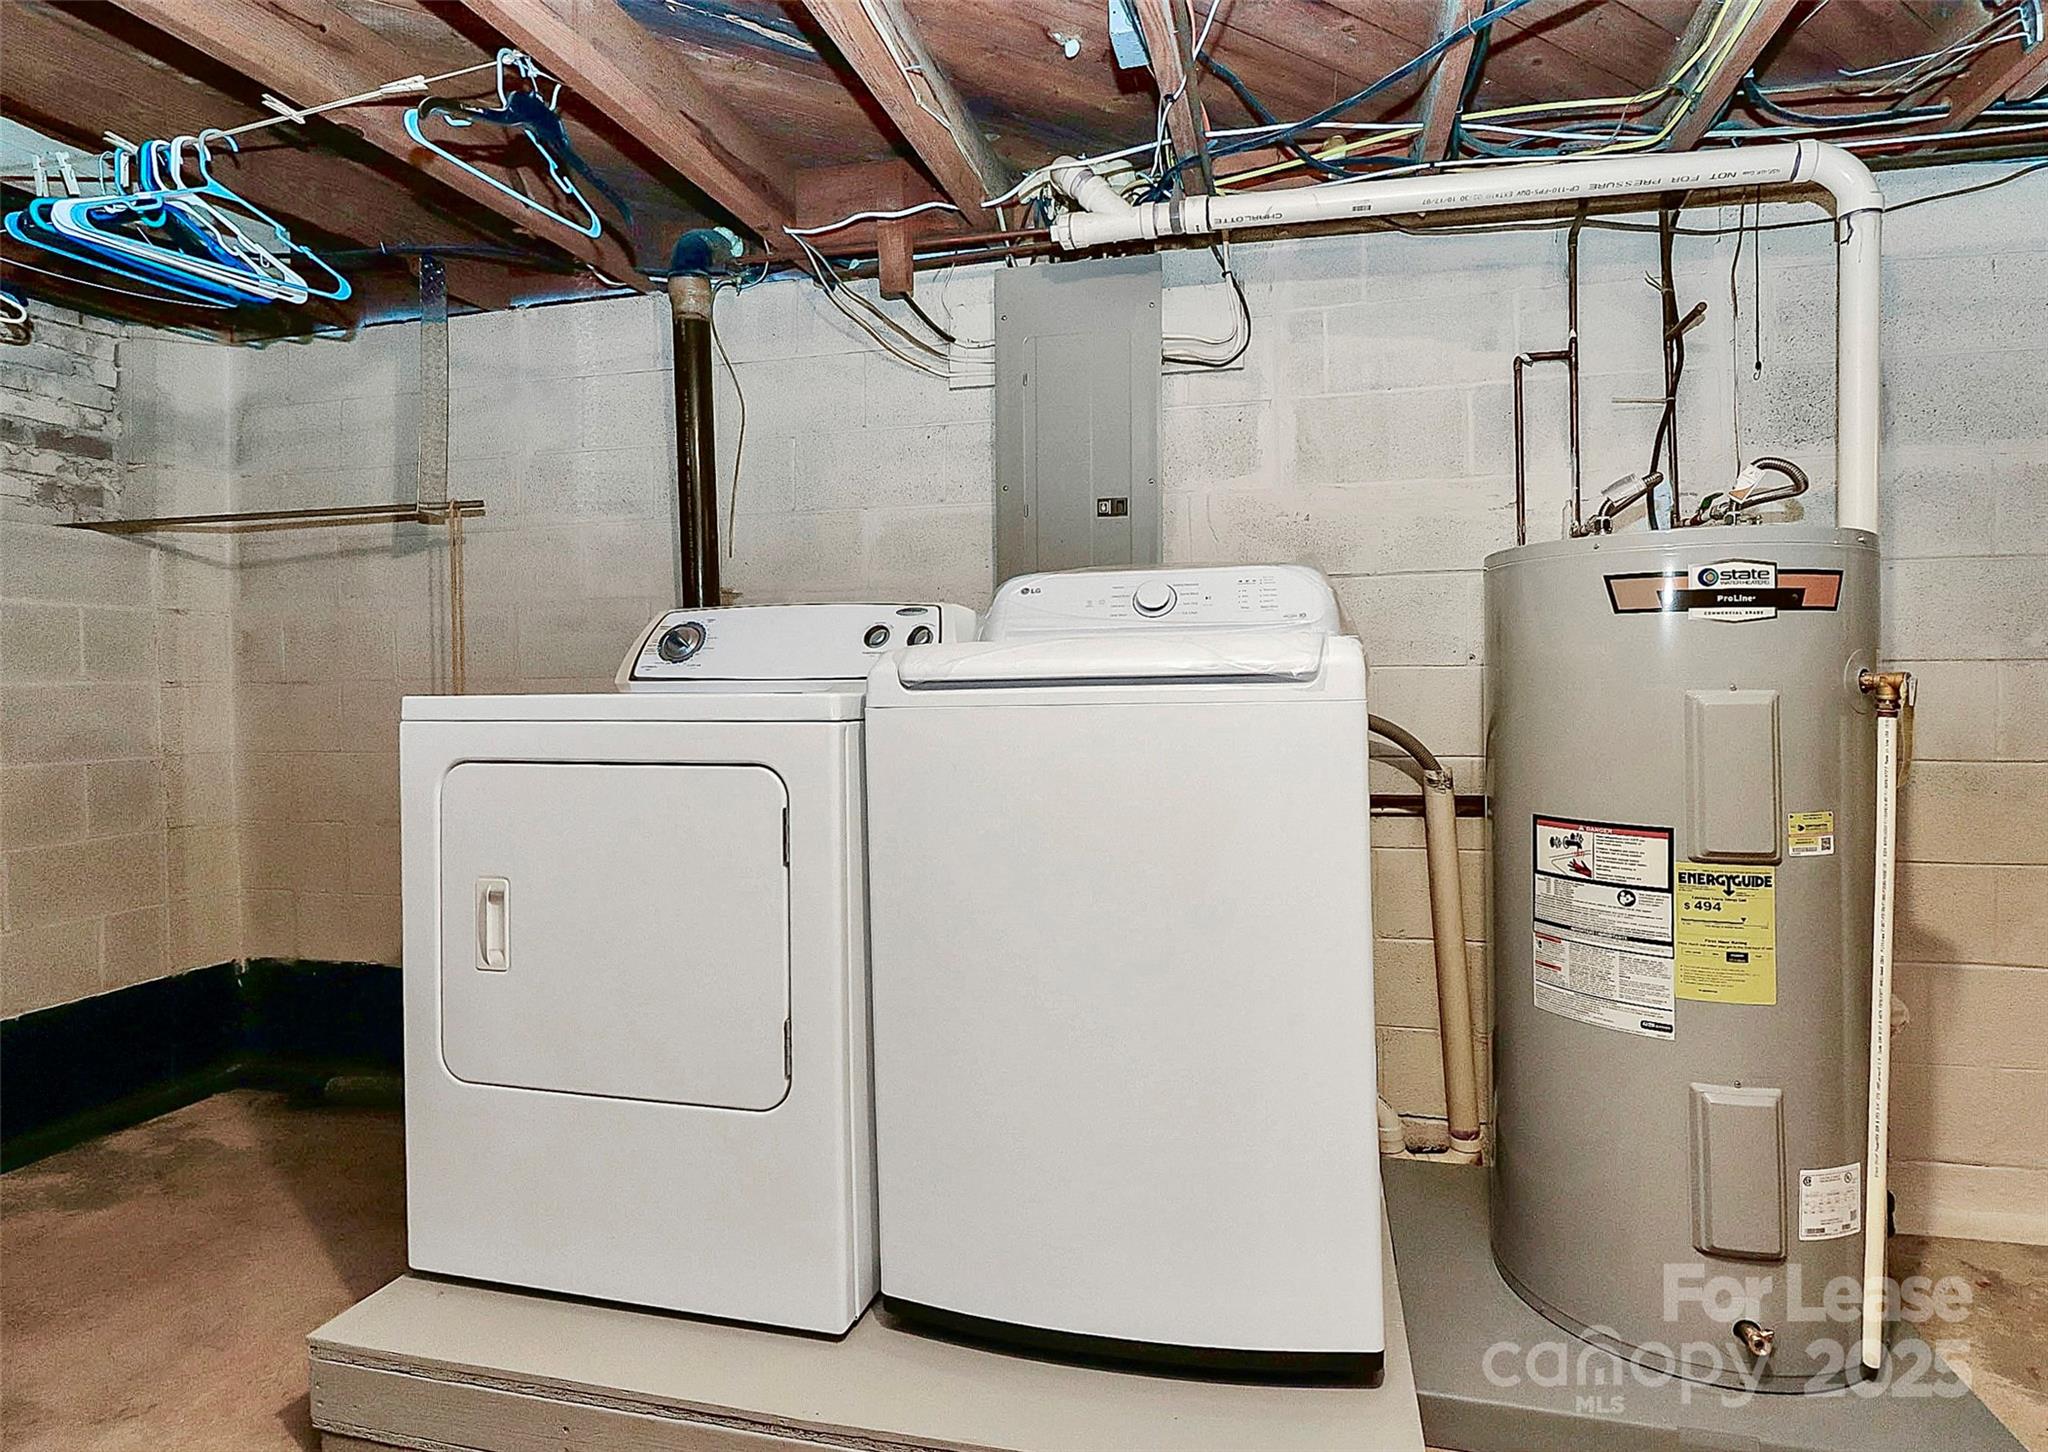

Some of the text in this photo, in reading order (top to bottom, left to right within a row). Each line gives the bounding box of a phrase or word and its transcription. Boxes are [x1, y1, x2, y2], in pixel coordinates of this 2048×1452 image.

[1671, 174, 1700, 184] FOR
[1709, 172, 1737, 181] NOT
[1589, 178, 1662, 190] PRESSURE
[1214, 212, 1283, 225] CHARLOTTE
[1720, 569, 1770, 581] state
[1717, 594, 1752, 602] ProLine
[1586, 826, 1613, 834] DANGER
[1678, 872, 1772, 888] ENERGYGUIDE
[1694, 900, 1722, 912] 494
